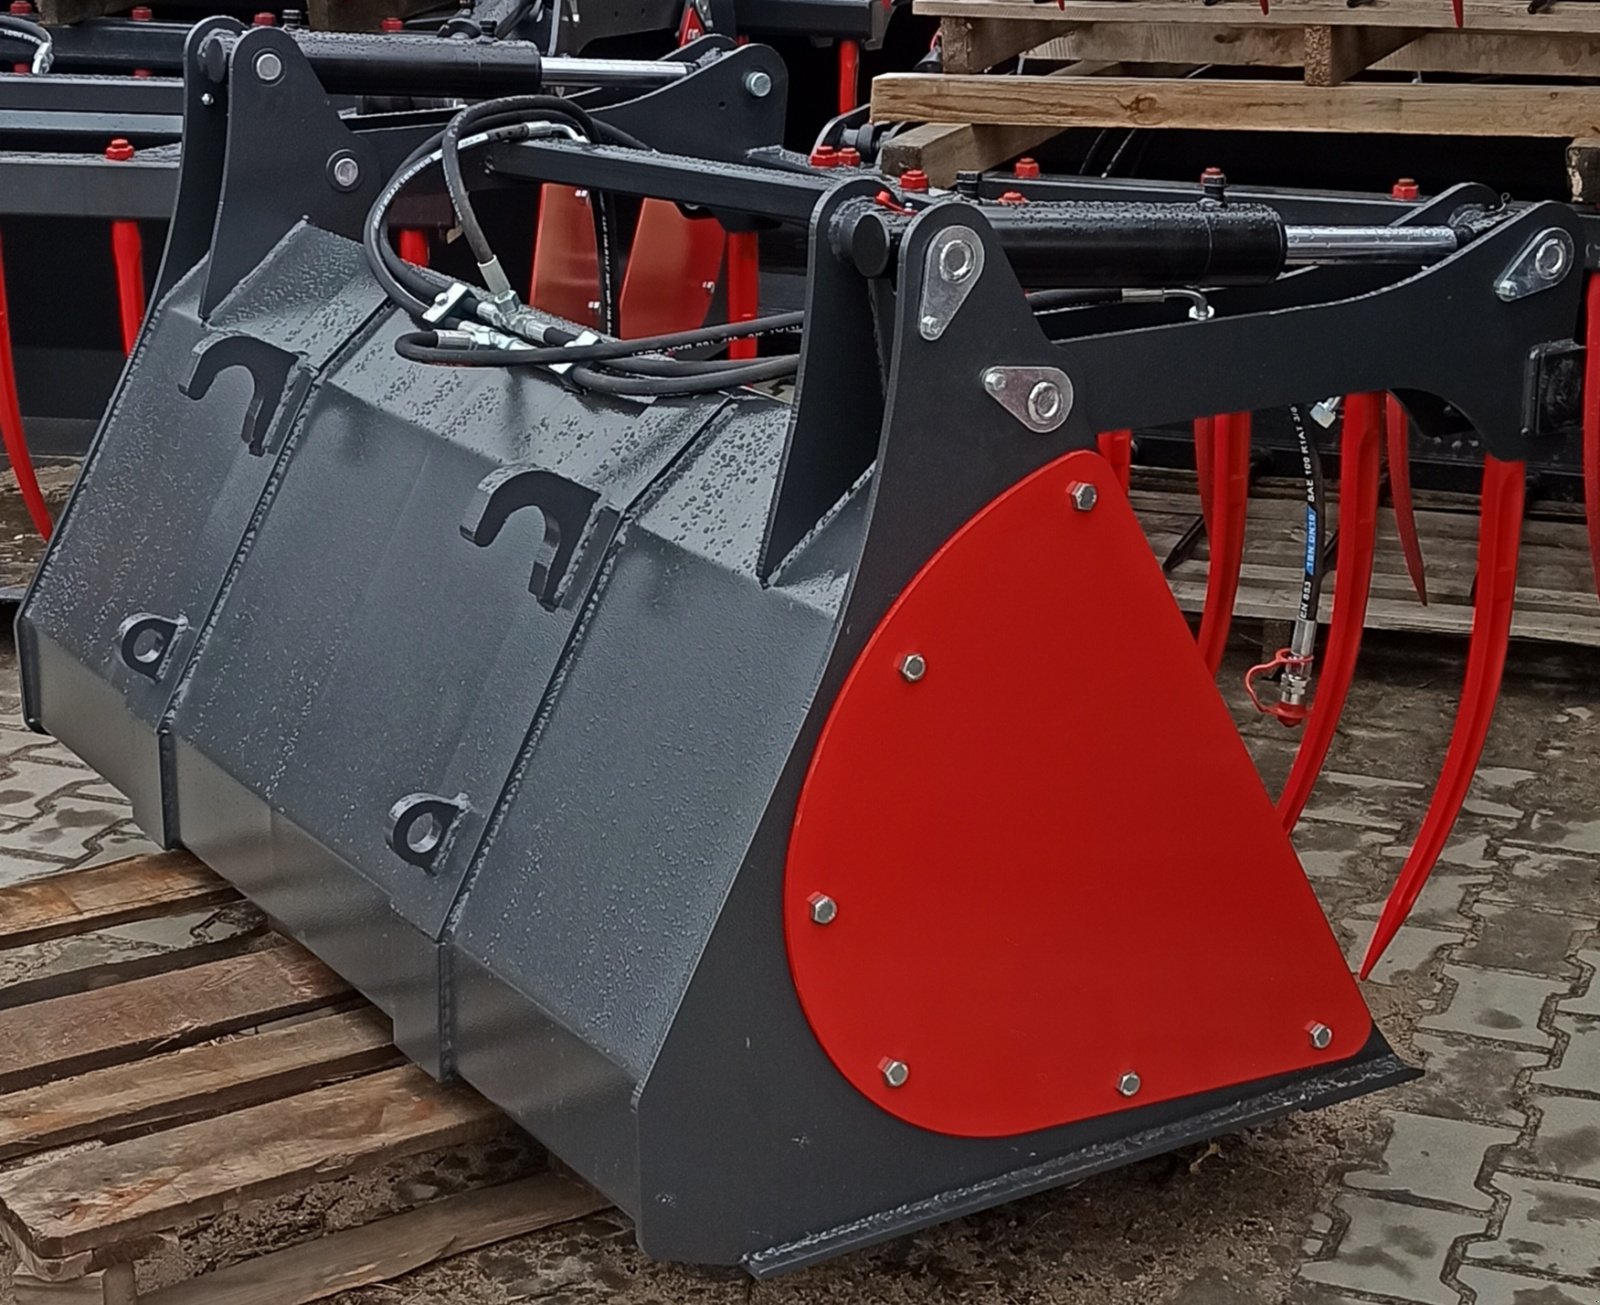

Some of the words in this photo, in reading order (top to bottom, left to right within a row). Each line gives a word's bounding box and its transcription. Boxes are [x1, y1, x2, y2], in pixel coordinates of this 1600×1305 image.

[1303, 456, 1312, 475] 100
[1306, 479, 1315, 502] SAE
[1303, 581, 1311, 600] 853
[1300, 602, 1309, 619] EN
